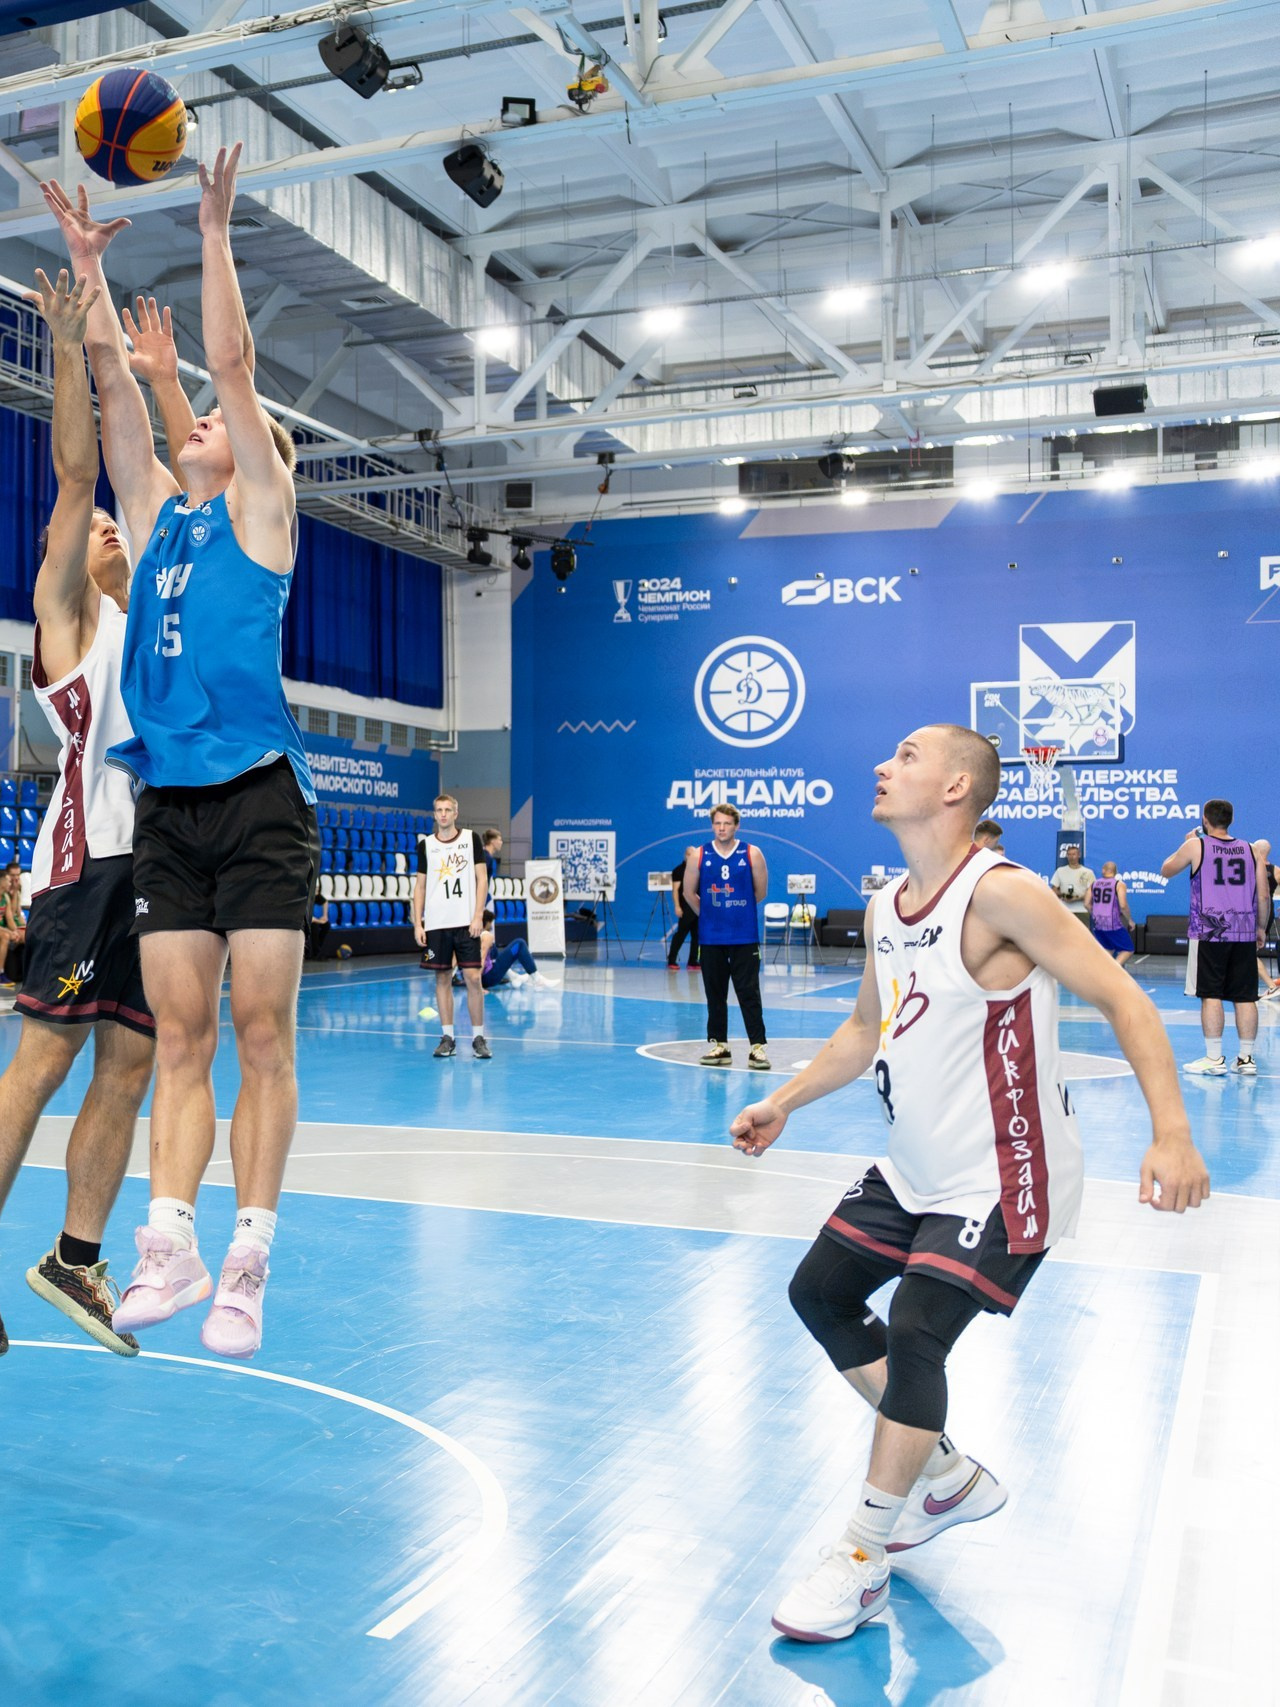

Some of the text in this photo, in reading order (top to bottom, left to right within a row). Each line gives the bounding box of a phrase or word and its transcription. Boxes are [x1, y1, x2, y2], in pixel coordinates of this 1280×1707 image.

[638, 589, 711, 604] ЧЕМПИОН
[833, 576, 902, 605] ВСК
[305, 752, 383, 778] РАВИТЕЛЬСТВО
[694, 766, 804, 778] БАСКЕТБОЛЬНЫЙ КЛУБ
[311, 773, 399, 798] ИМОРСКОГО КРАЯ
[666, 779, 834, 810] ДИНАМО
[994, 787, 1179, 802] РАВИТЕЛЬСТВА
[694, 807, 805, 818] ПРСКИЙ КРАЙ
[1136, 804, 1200, 819] КРАЯ
[721, 864, 730, 880] 8
[1213, 857, 1246, 886] 13
[443, 878, 463, 899] 14
[1093, 887, 1113, 904] 96
[958, 1218, 986, 1250] 8
